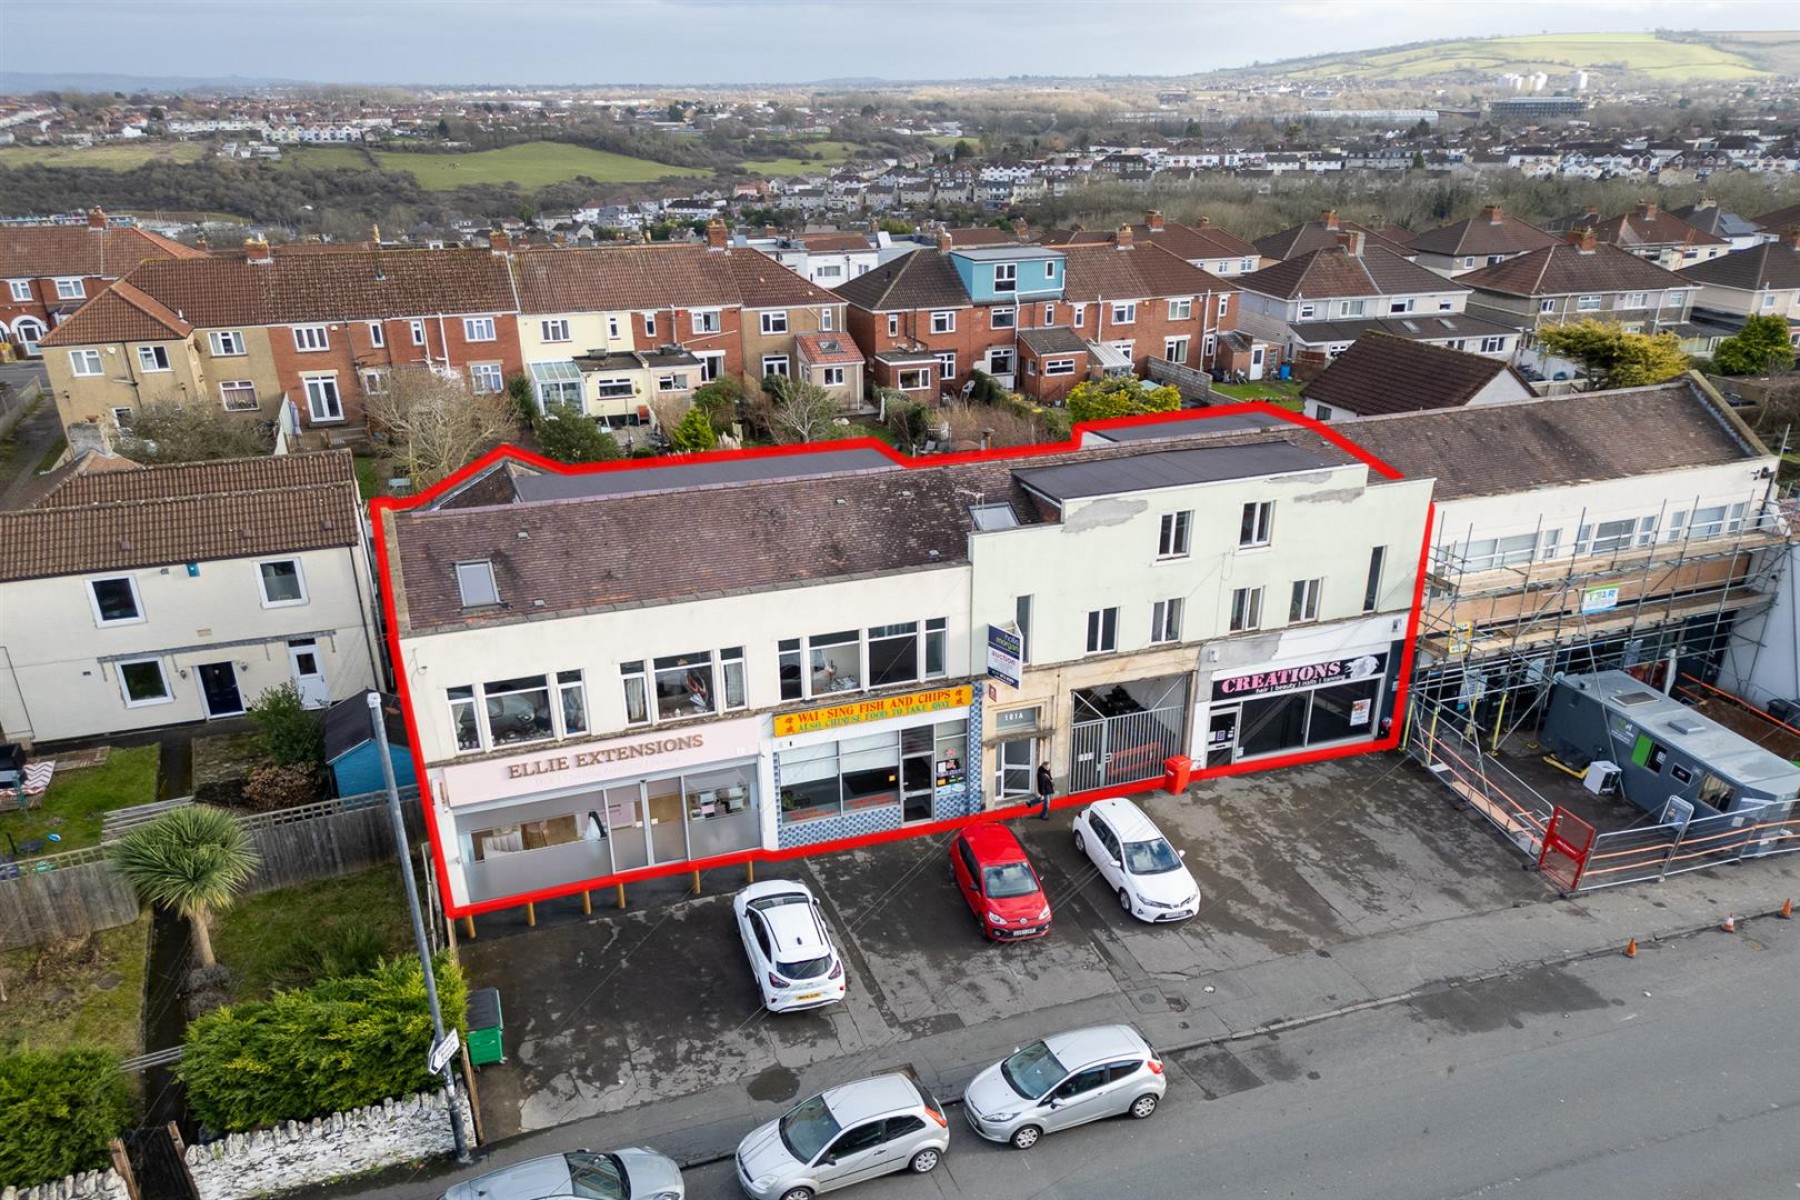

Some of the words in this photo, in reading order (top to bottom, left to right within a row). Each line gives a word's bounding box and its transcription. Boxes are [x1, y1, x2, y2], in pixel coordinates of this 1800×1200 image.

[1221, 661, 1341, 694] CREATIONS
[1275, 683, 1297, 691] beauty
[799, 721, 821, 731] ALSO
[826, 714, 860, 728] CHINESE
[865, 709, 888, 721] FOOD
[892, 708, 903, 717] TO
[906, 703, 926, 715] TAKE
[931, 700, 949, 710] AWAY
[827, 705, 854, 719] SING
[859, 700, 885, 713] FISH
[890, 695, 913, 709] AND
[918, 689, 951, 704] CHIPS
[1004, 711, 1024, 721] 101A
[507, 755, 570, 780] ELLIE
[576, 734, 705, 768] EXTENSIONS
